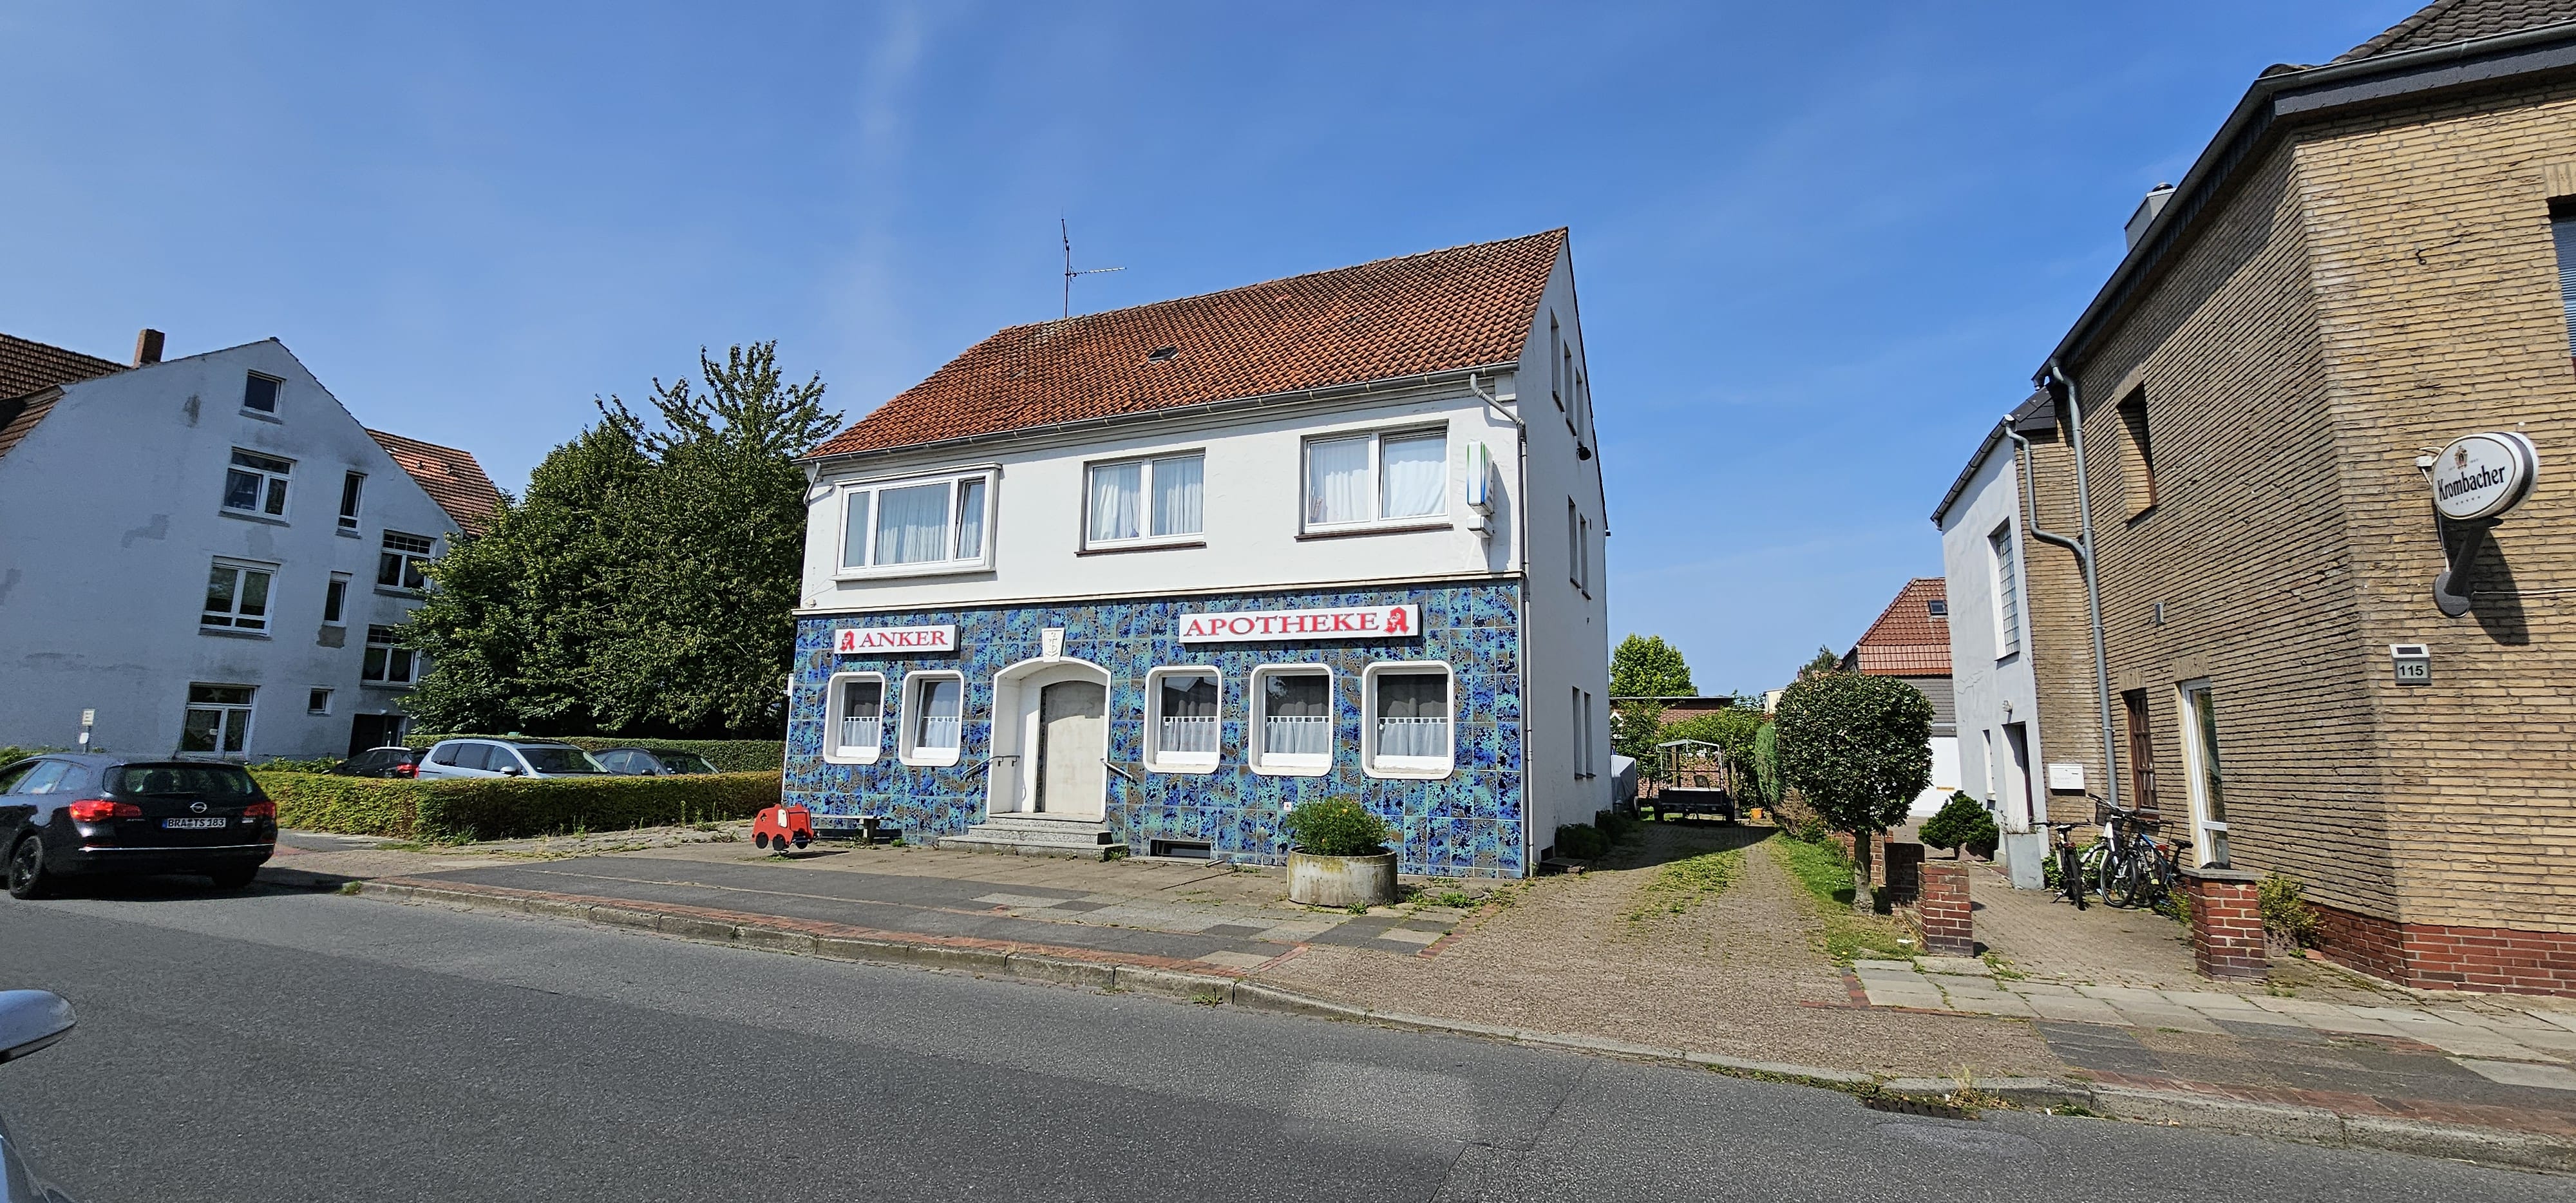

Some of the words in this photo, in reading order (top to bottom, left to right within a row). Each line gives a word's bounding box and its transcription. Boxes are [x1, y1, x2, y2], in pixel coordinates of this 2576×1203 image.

[2437, 464, 2505, 501] Krombacher
[1183, 612, 1379, 637] APOTHEKE
[859, 630, 948, 648] ANKER
[2400, 665, 2423, 676] 115
[168, 819, 186, 827] BRA
[194, 819, 205, 827] TS
